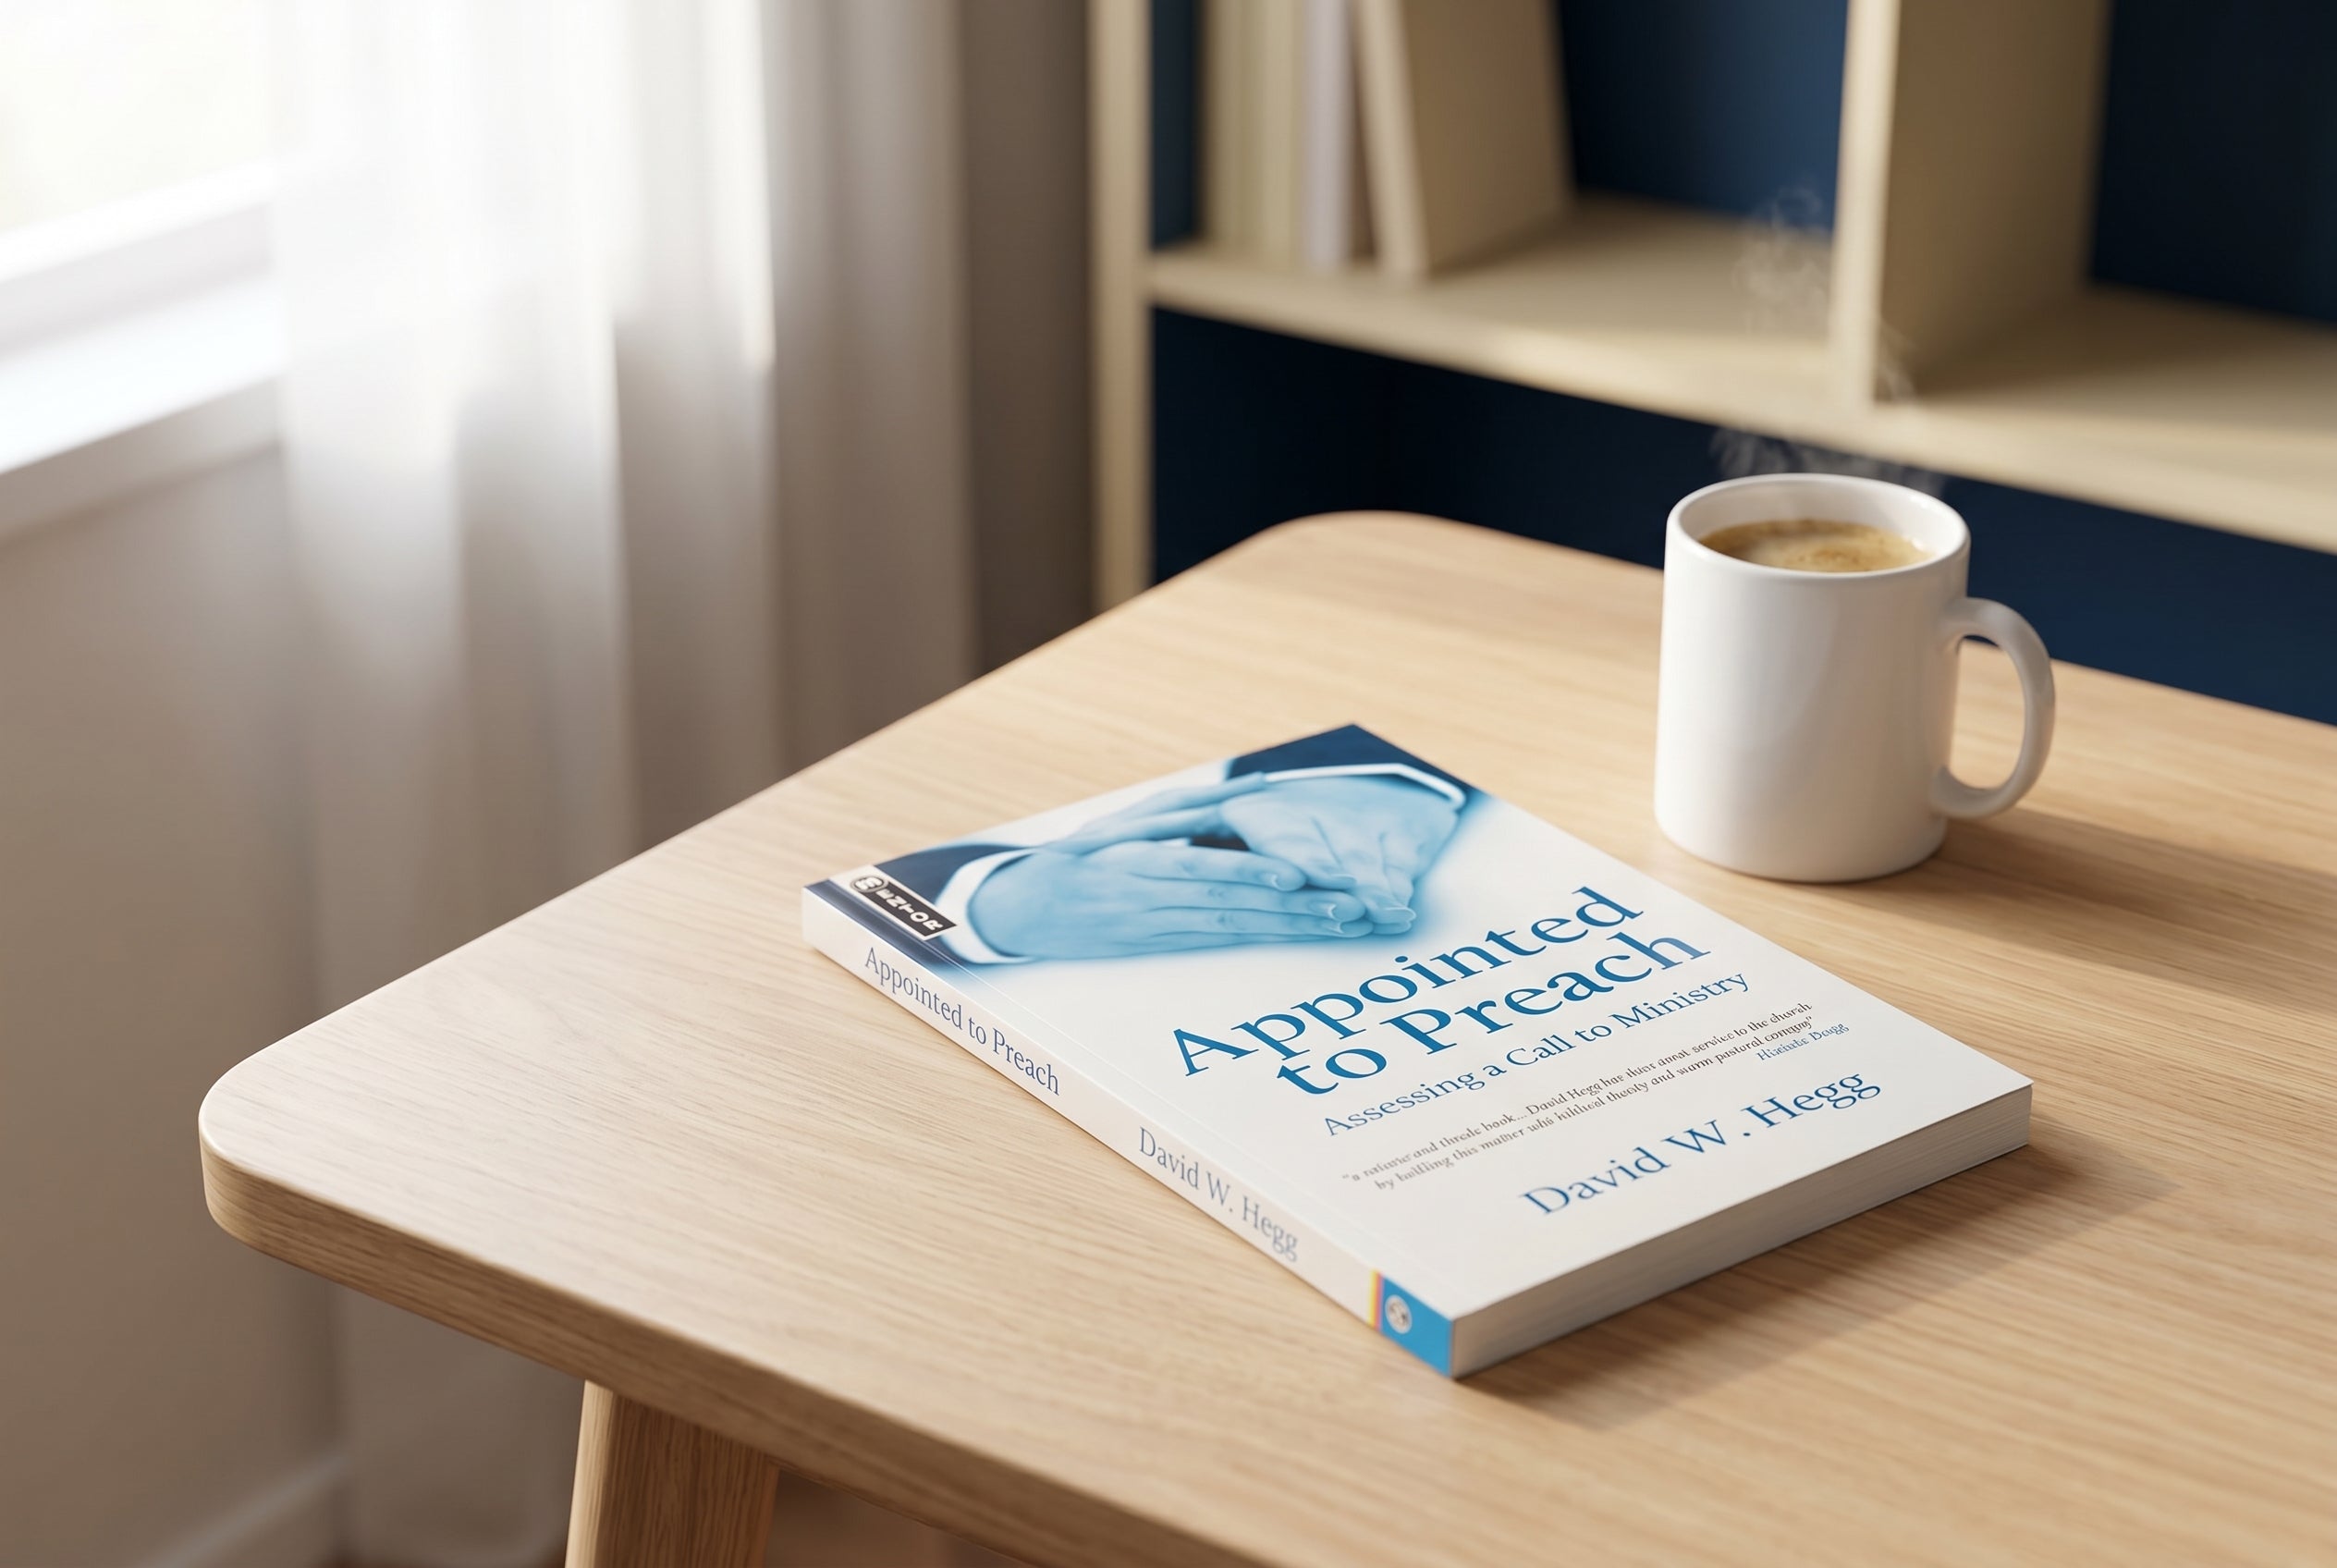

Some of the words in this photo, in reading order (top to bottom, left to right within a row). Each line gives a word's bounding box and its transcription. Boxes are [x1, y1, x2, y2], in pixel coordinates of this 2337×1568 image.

[864, 947, 963, 1031] Appointed
[968, 1017, 986, 1045] to
[992, 1027, 1060, 1096] Preach
[1171, 885, 1645, 1078] Appointed
[1276, 1047, 1389, 1096] to
[1380, 931, 1712, 1055] Preach
[1325, 1071, 1486, 1136] Assessing
[1482, 1064, 1508, 1077] a
[1506, 1035, 1576, 1067] Call
[1572, 1022, 1613, 1046] to
[1608, 974, 1750, 1031] Ministry
[1413, 1142, 1438, 1158] and
[1525, 1093, 1569, 1116] David
[1733, 1026, 1748, 1036] to
[1747, 1018, 1769, 1033] the
[1651, 1069, 1676, 1086] and
[1714, 1036, 1765, 1064] pastoral
[1138, 1126, 1200, 1190] David
[1205, 1170, 1234, 1213] W.
[1241, 1195, 1299, 1264] Hegg
[1519, 1146, 1671, 1215] David
[1741, 1073, 1881, 1128] Hegg
